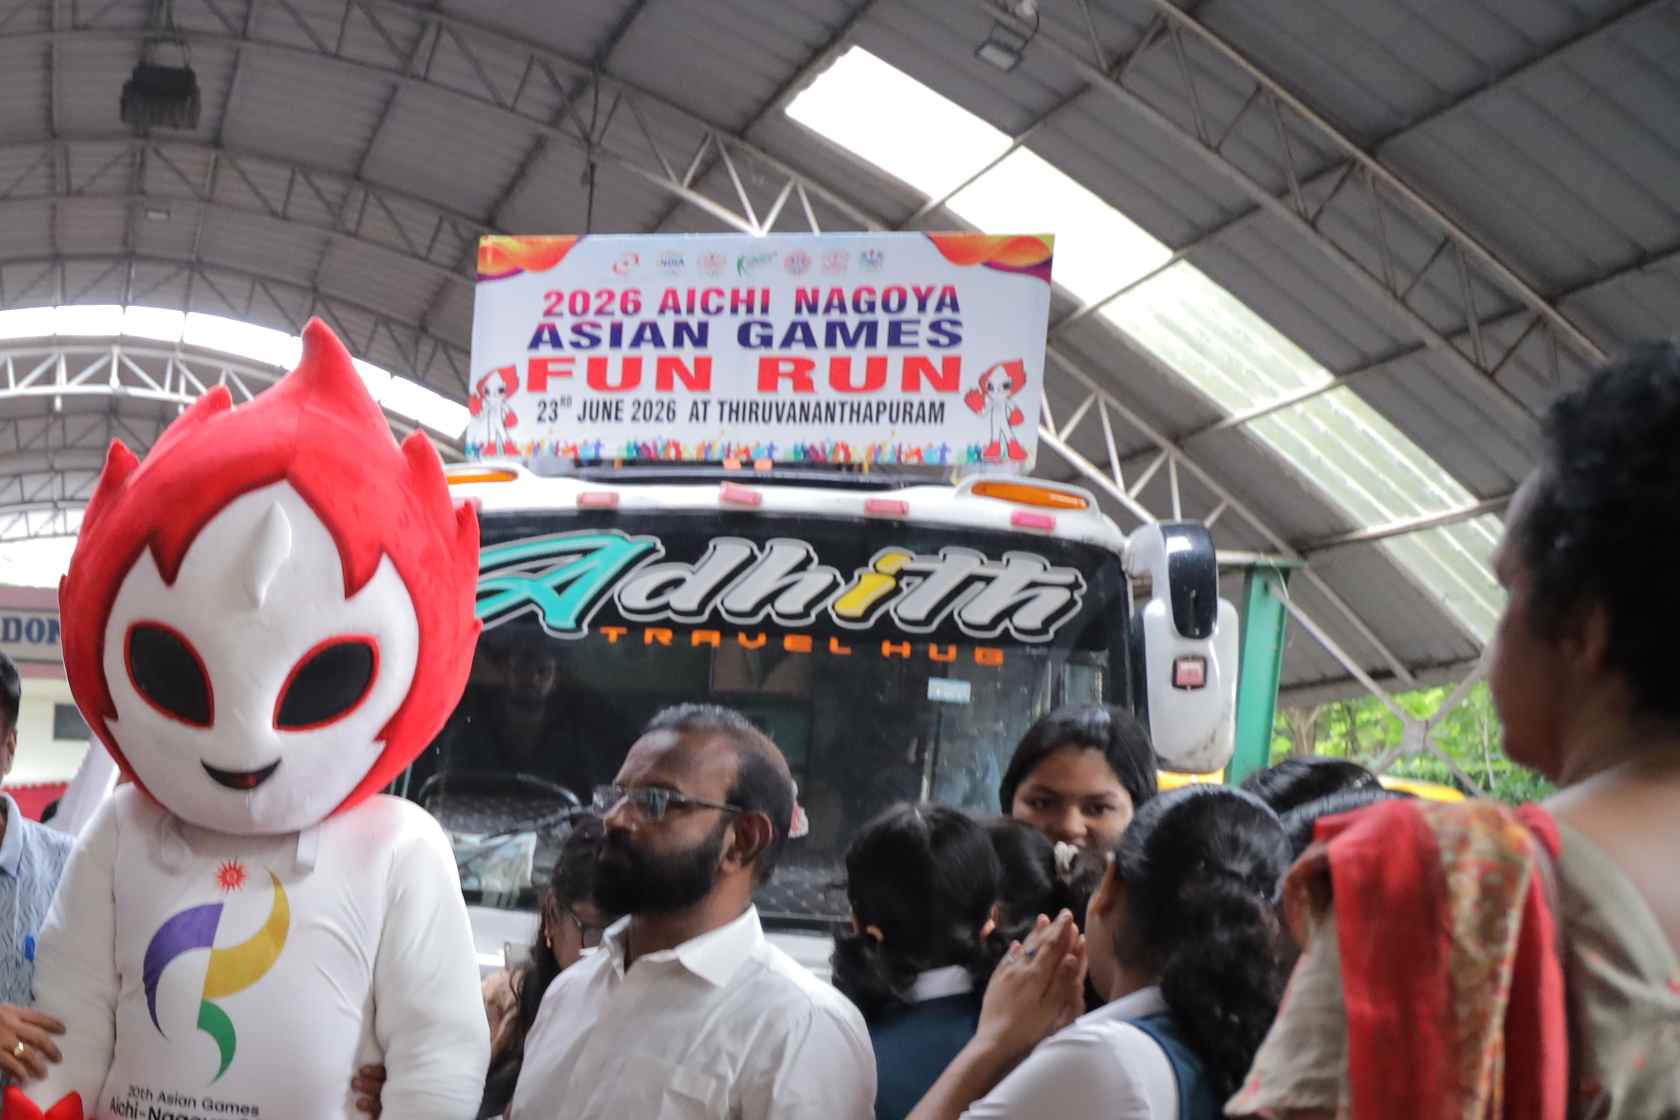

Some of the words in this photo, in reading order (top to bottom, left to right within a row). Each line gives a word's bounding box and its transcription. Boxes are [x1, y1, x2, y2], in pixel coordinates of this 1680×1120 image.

[543, 287, 642, 317] 2026
[657, 286, 770, 316] AICHI
[794, 283, 961, 315] NAGOYA
[527, 320, 710, 350] ASIAN
[736, 318, 963, 349] GAMES
[526, 355, 713, 393] FUN
[757, 354, 962, 394] RUN
[577, 400, 624, 424] JUNE
[630, 400, 677, 423] 2026
[688, 401, 715, 424] AT
[717, 400, 945, 425] THIRUVANANTHAPURAM
[599, 626, 853, 656] TRAVEL
[881, 639, 1005, 666] HUB
[127, 1085, 154, 1102] 20th
[158, 1089, 197, 1109] Asian
[201, 1096, 260, 1117] Games
